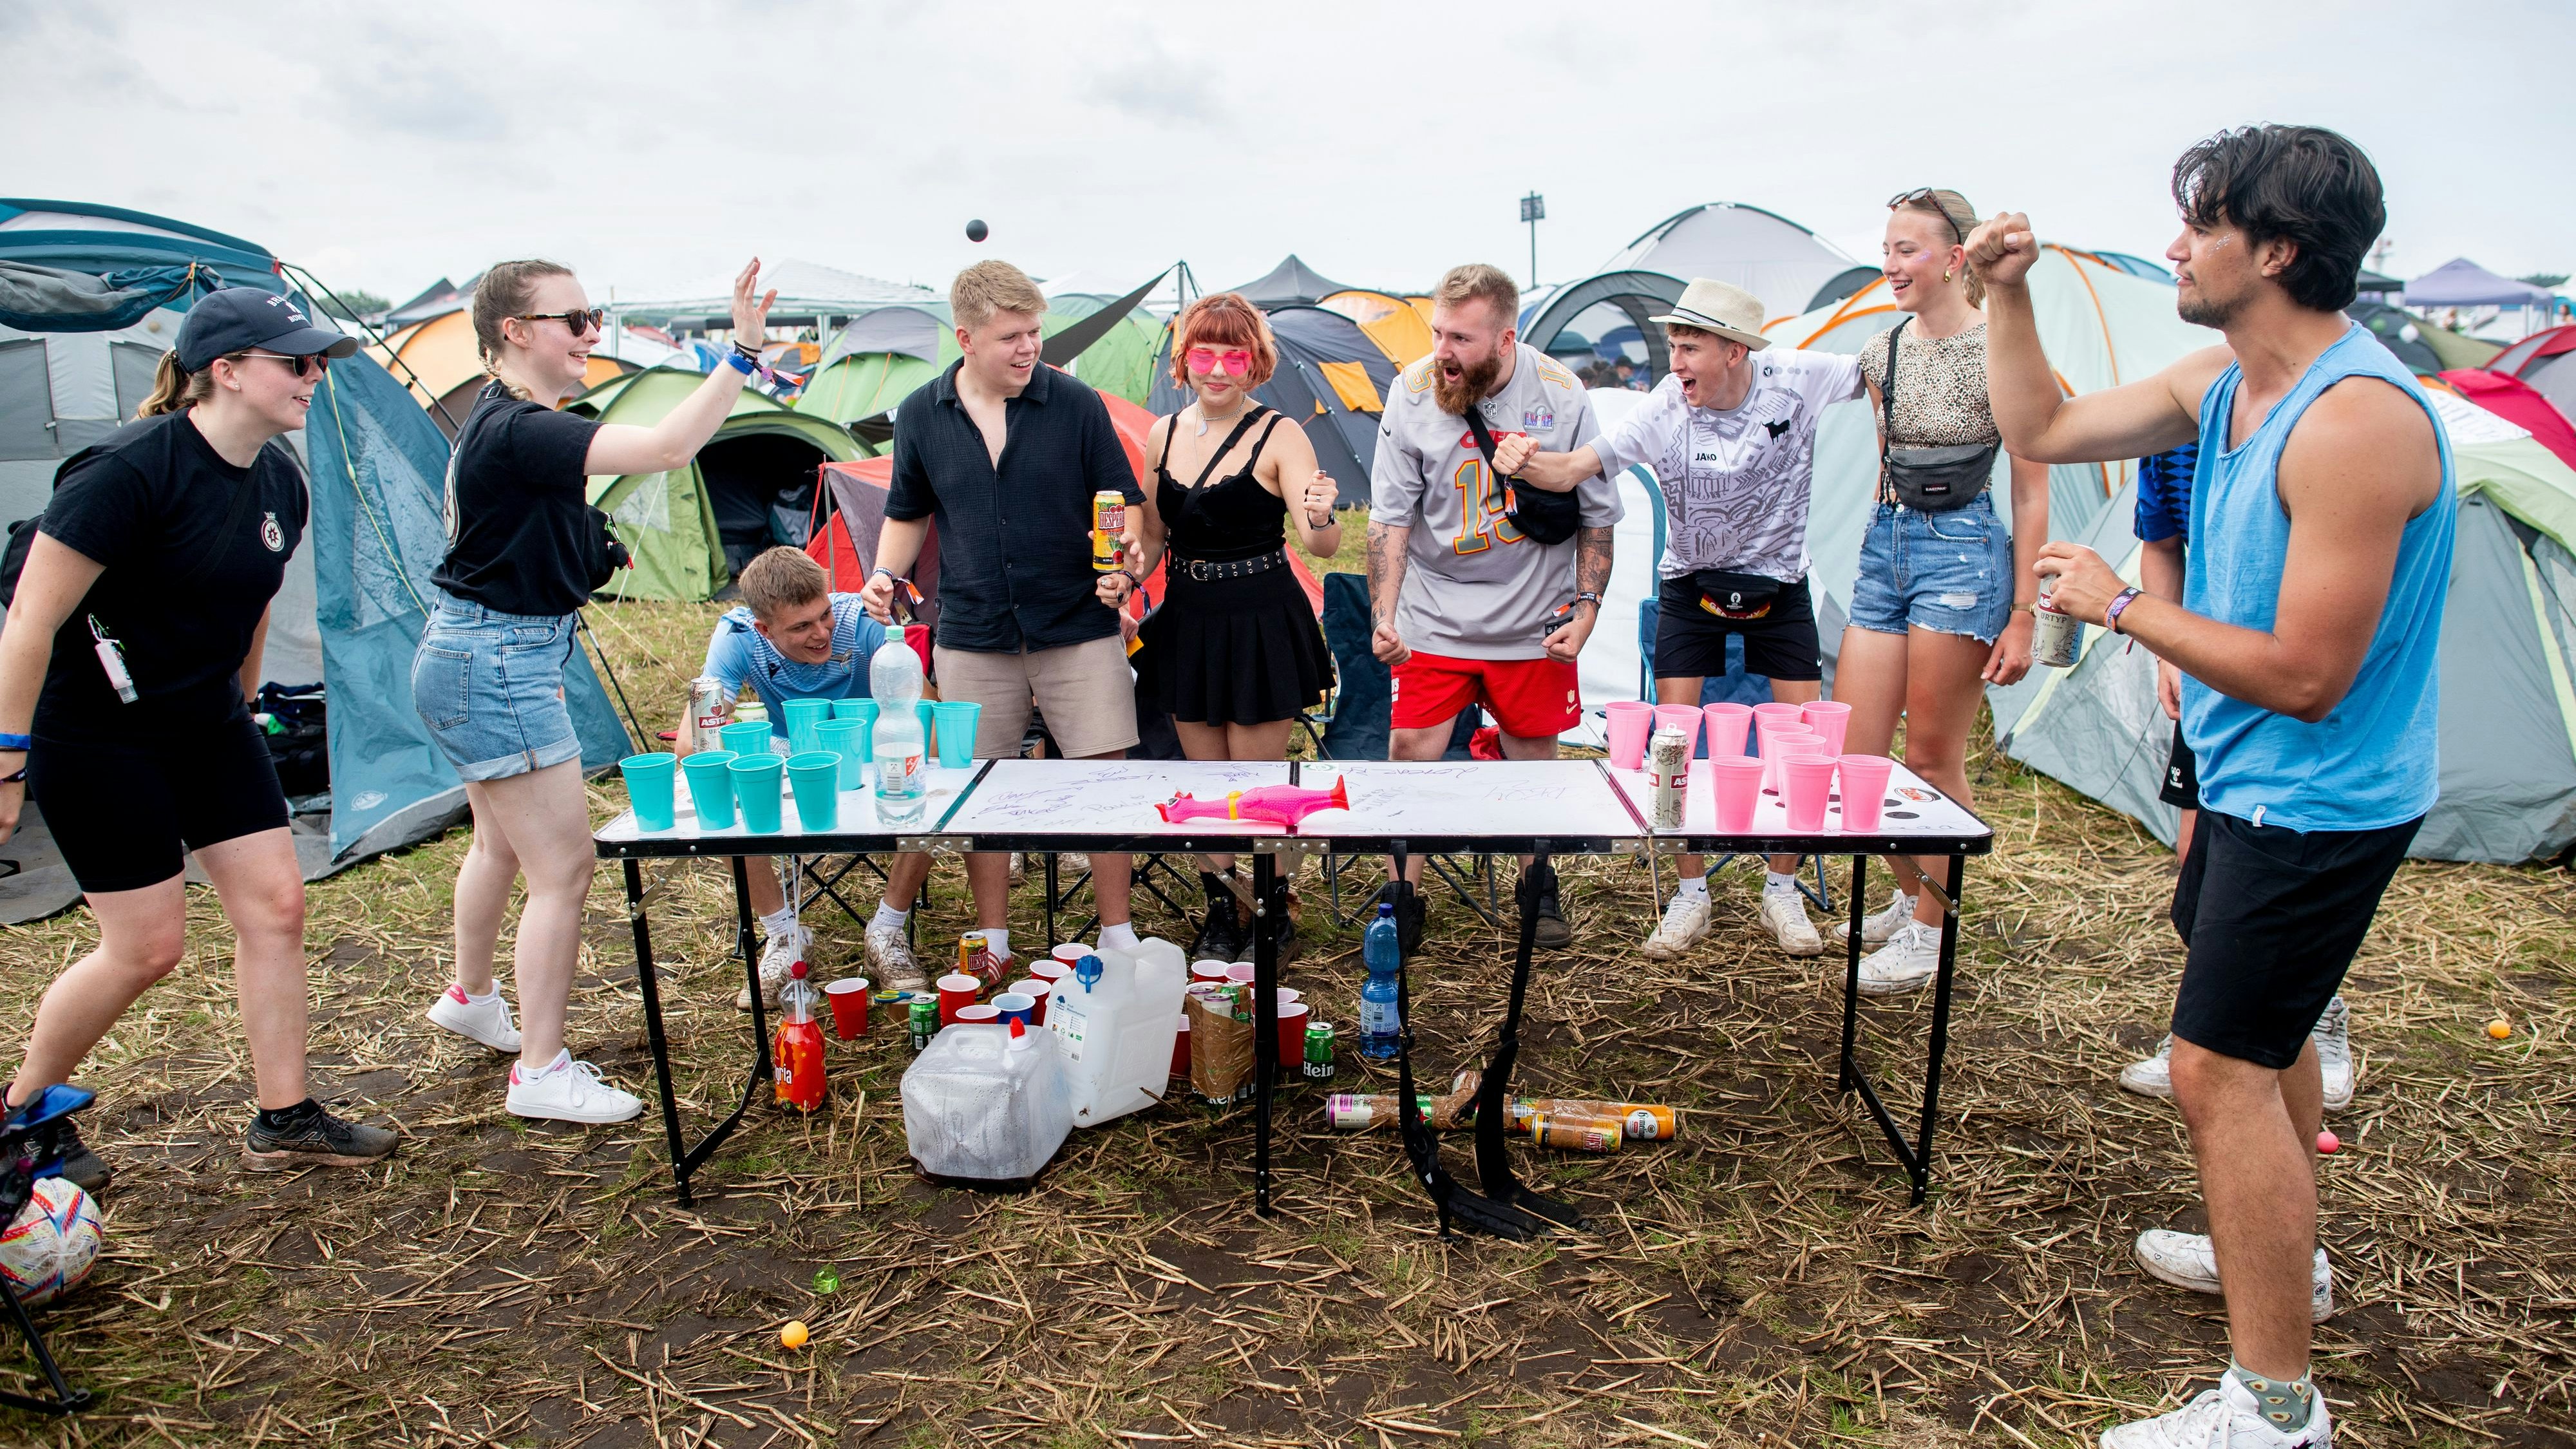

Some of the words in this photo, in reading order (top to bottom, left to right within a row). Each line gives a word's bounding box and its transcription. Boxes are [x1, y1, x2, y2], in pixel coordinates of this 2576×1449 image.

[1695, 453, 1717, 461] JAKO
[2041, 612, 2067, 624] URTYP
[1303, 1061, 1335, 1077] Hein
